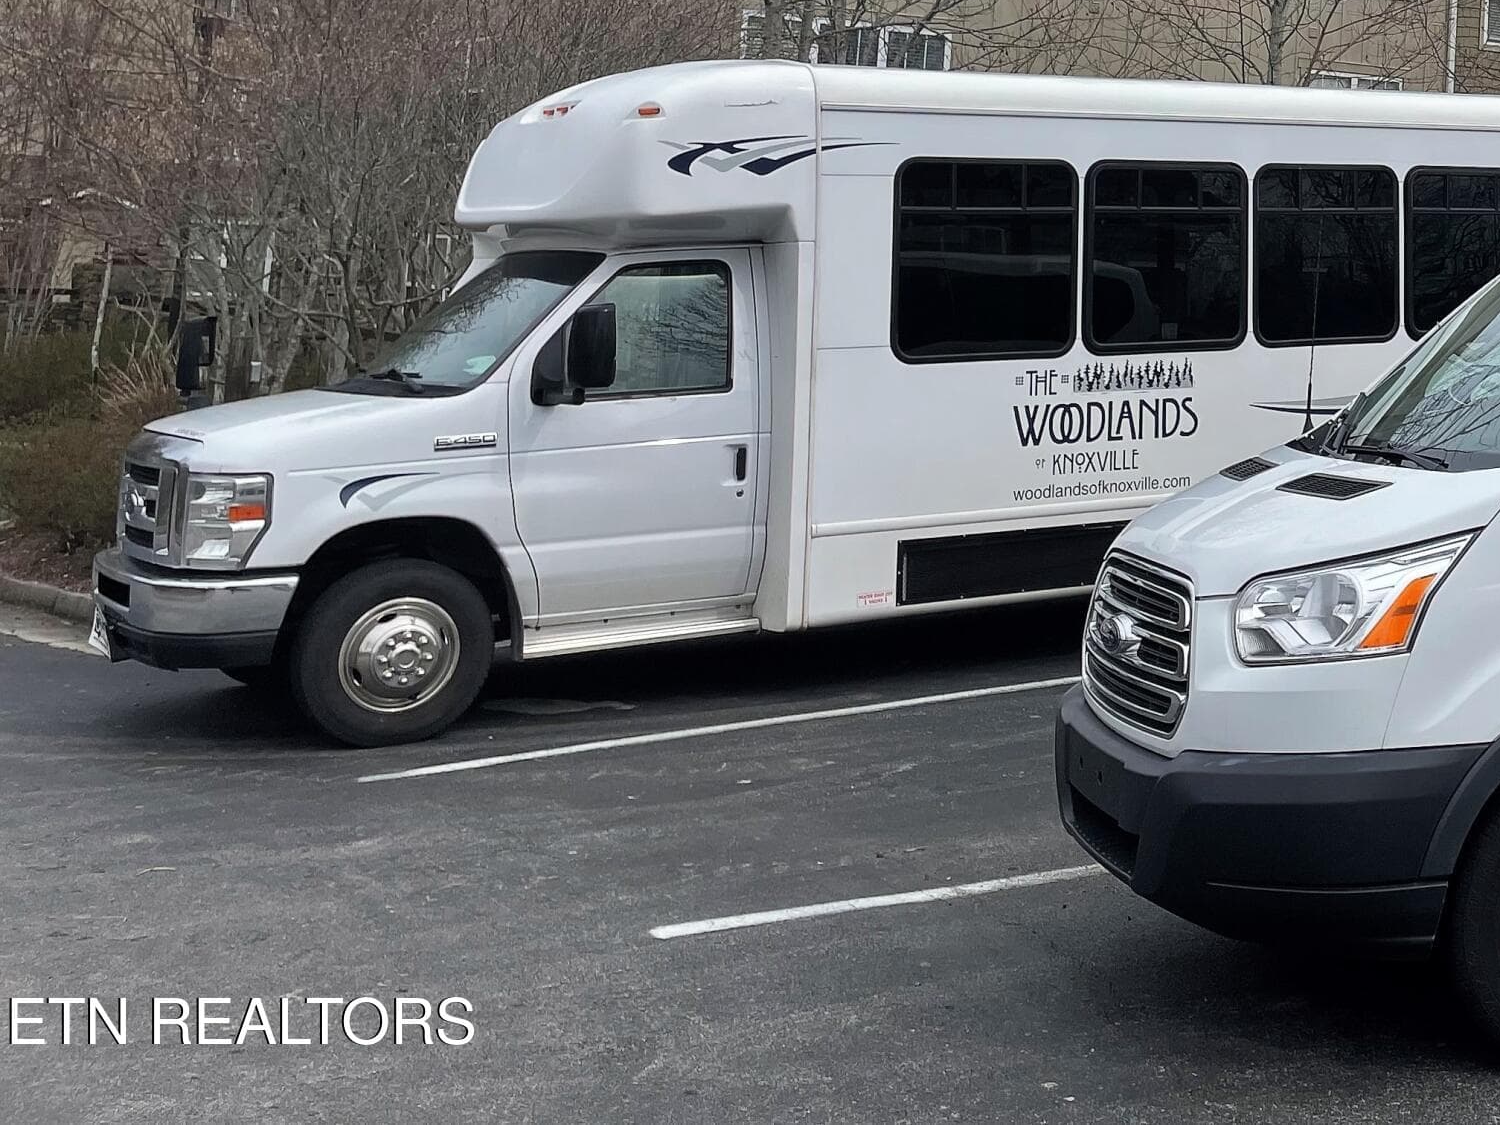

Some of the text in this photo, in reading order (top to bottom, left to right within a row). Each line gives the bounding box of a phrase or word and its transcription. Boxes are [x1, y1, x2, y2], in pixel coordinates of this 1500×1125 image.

[1025, 369, 1058, 396] THE
[1013, 397, 1198, 447] WOODLANDS
[435, 434, 496, 447] E-450
[1052, 449, 1139, 475] KNOXVILLE
[1013, 475, 1191, 501] woodlandsofknoxville.com
